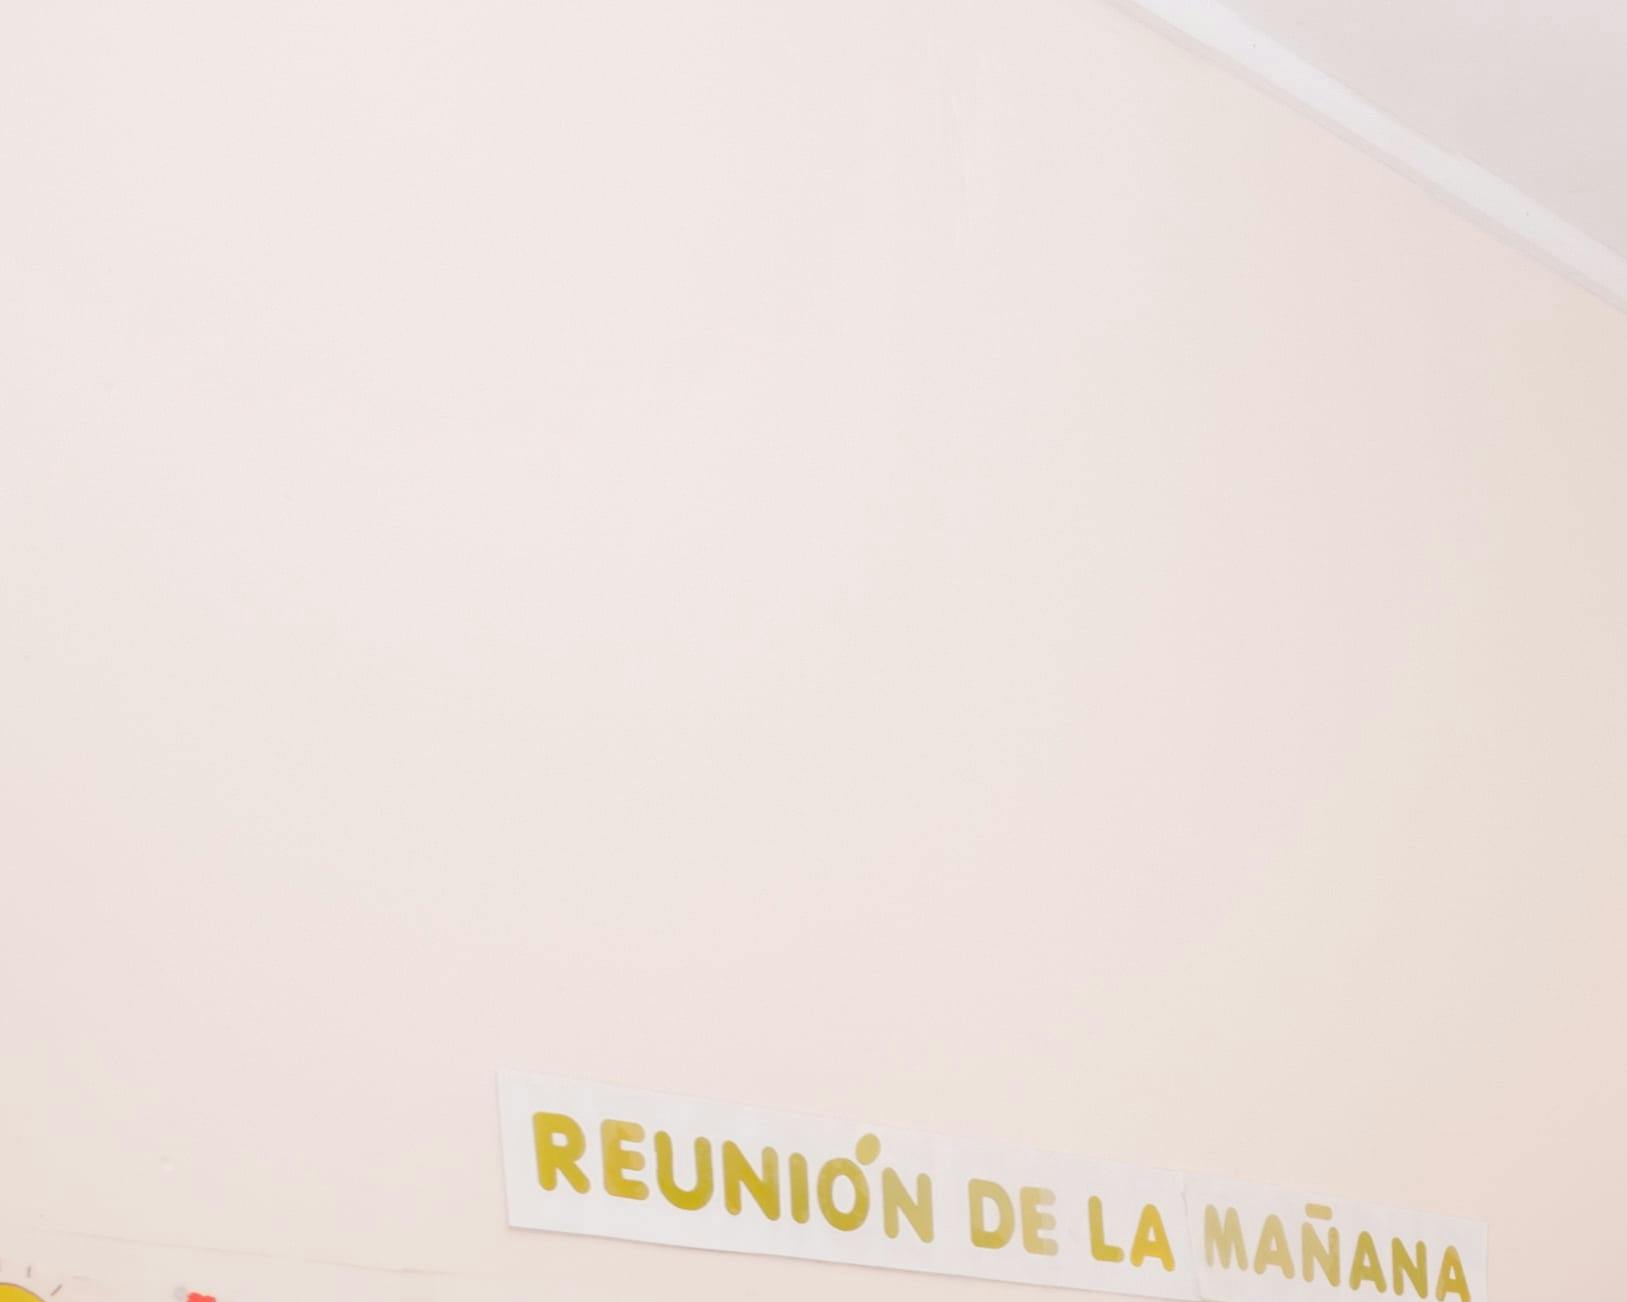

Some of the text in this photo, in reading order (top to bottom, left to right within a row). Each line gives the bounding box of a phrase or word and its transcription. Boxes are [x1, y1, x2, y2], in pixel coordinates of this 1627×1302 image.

[532, 1111, 934, 1244] REUNIÓN
[969, 1177, 1059, 1258] DE
[1088, 1194, 1176, 1272] LA
